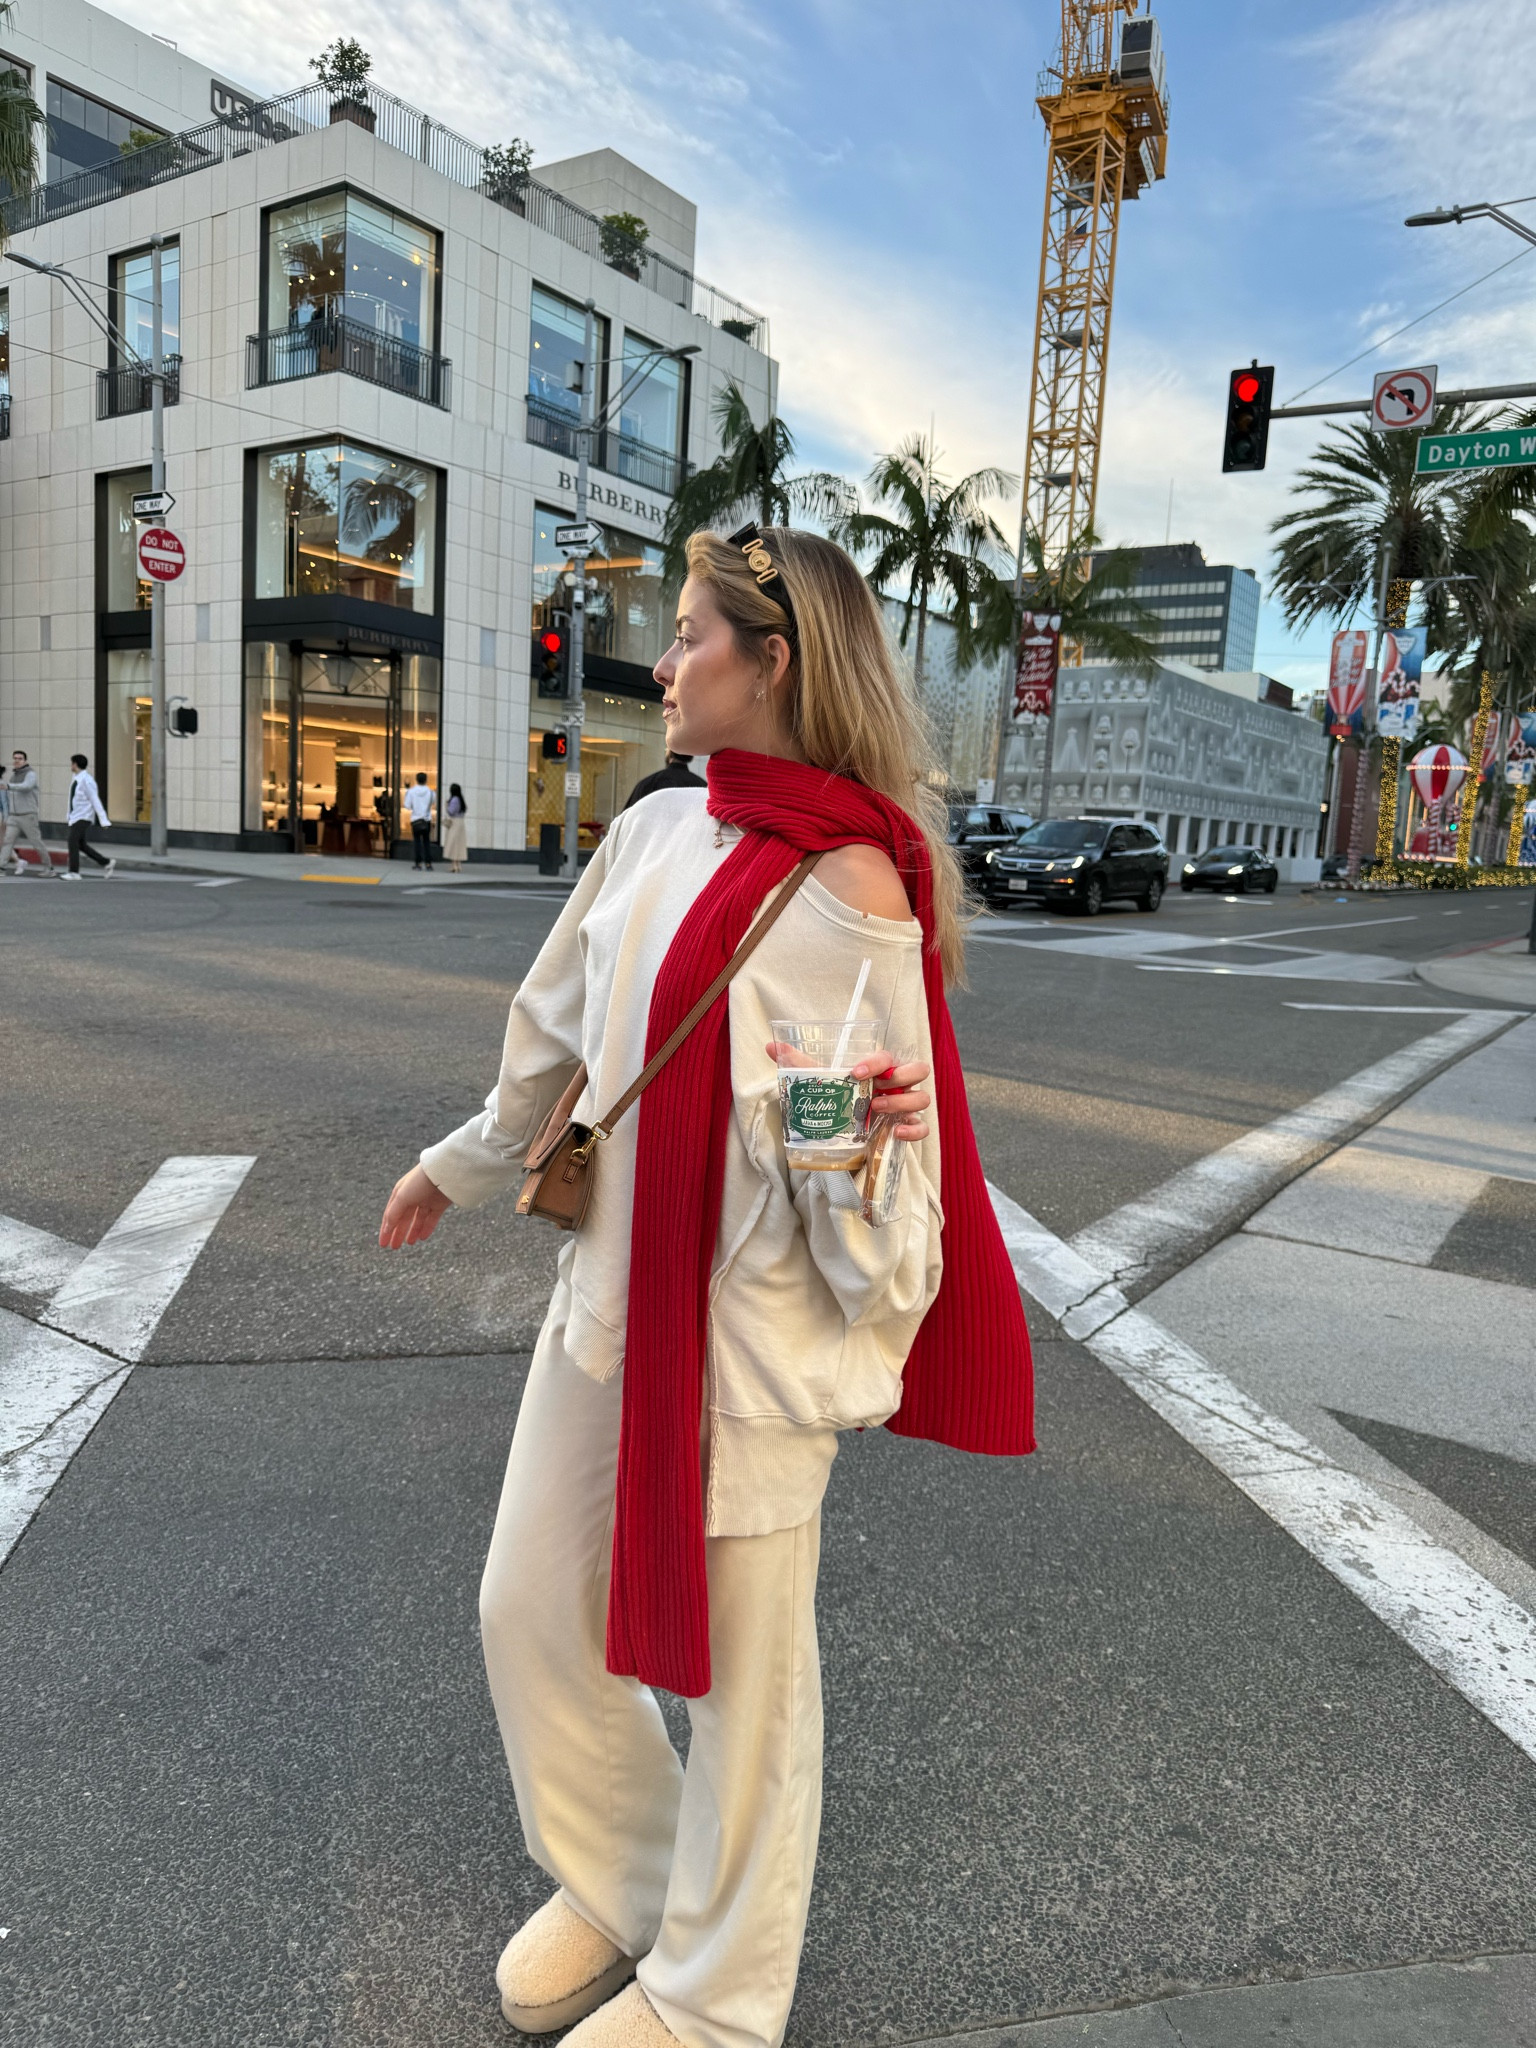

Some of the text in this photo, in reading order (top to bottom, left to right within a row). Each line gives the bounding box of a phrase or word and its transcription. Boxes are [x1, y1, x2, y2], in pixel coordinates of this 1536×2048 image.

[1428, 442, 1511, 466] Dayton
[135, 500, 161, 512] ONE WAY
[145, 535, 179, 551] DO NOT
[559, 531, 586, 541] ONE WAY
[148, 560, 177, 574] ENTER
[348, 626, 429, 653] BURBERRY
